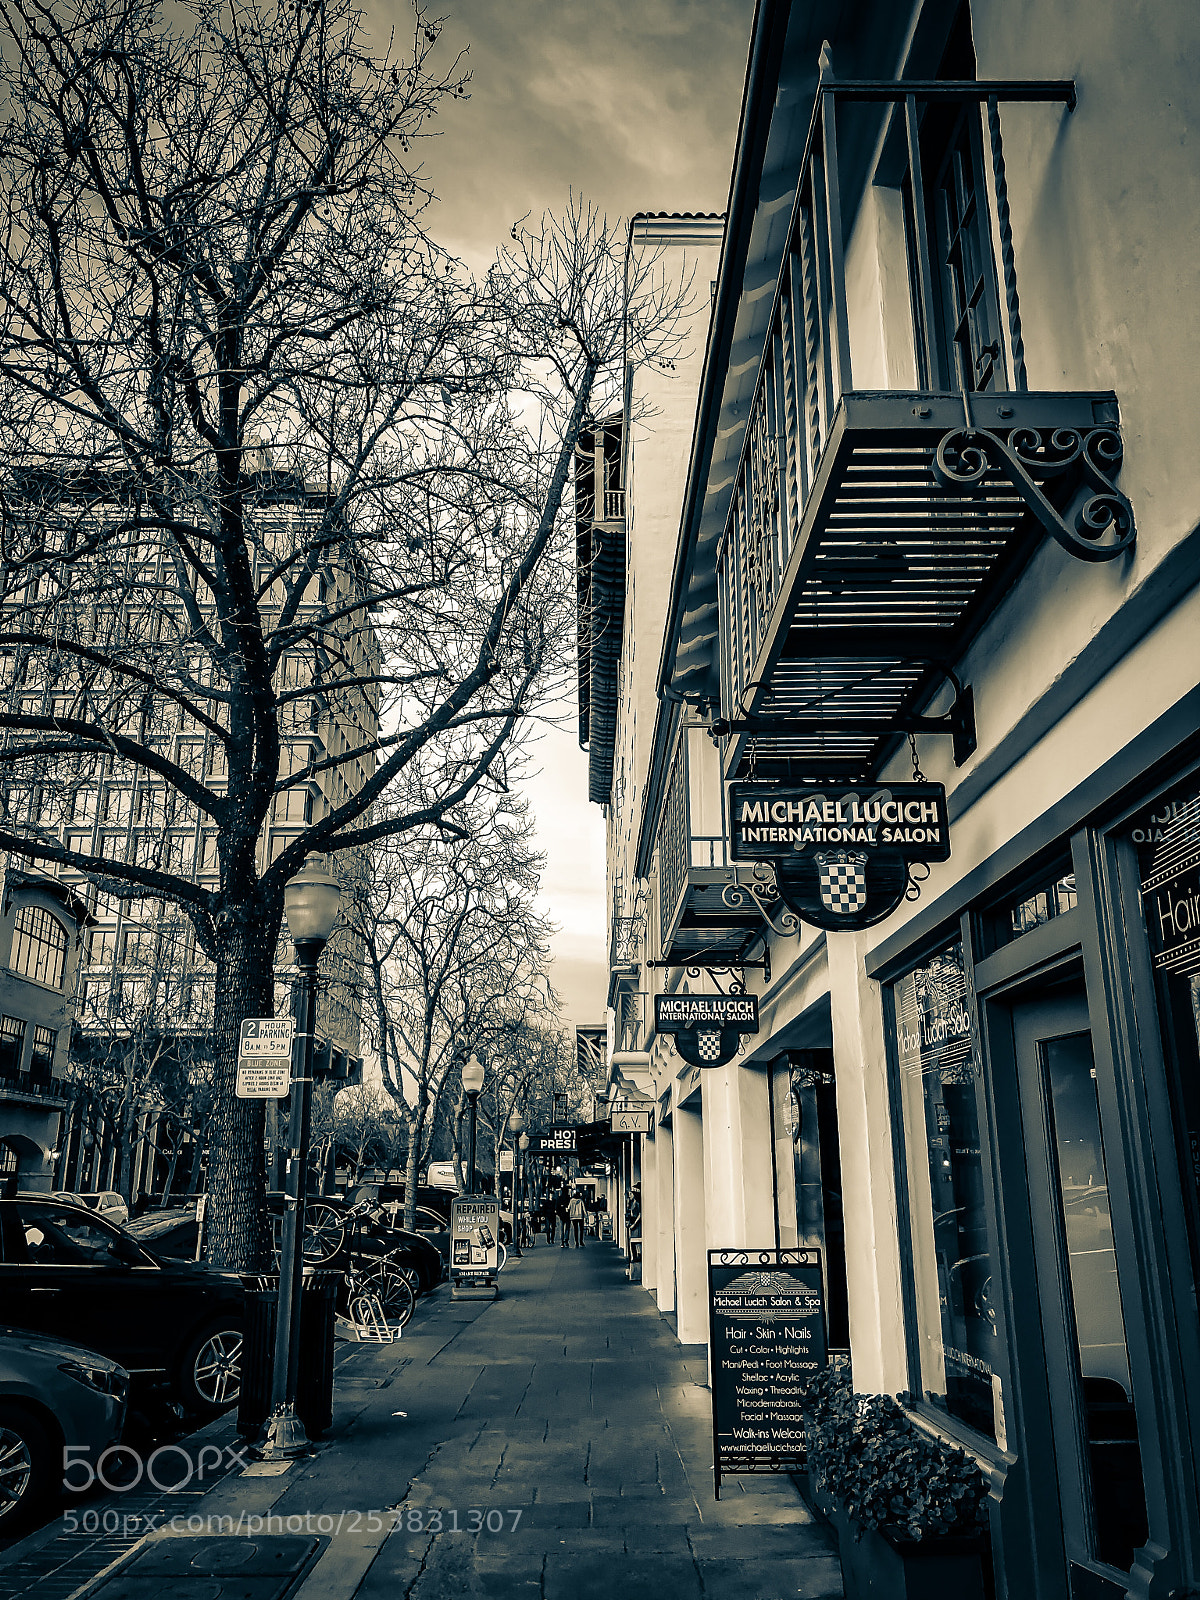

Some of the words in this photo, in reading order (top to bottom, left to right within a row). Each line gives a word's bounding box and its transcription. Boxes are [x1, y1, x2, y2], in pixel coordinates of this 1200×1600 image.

[741, 801, 847, 823] MICHAEL
[852, 801, 939, 823] LUCICH
[741, 827, 877, 842] INTERNATIONAL
[882, 827, 940, 842] SALON
[1157, 888, 1200, 941] Hair
[660, 1001, 711, 1012] MICHAEL
[713, 1001, 754, 1012] LUCICH
[659, 1012, 725, 1020] INTERNATIONAL
[726, 1012, 754, 1020] SALON
[247, 1021, 256, 1037] 2
[260, 1029, 290, 1038] PARKING
[457, 1204, 496, 1214] REPAIRED
[477, 1215, 489, 1223] YOU
[713, 1297, 742, 1306] Michael
[744, 1297, 768, 1306] Lucich
[770, 1297, 792, 1306] Salon
[795, 1297, 801, 1306] &
[804, 1297, 821, 1309] Spa
[725, 1327, 747, 1339] Hair
[755, 1327, 776, 1339] Skin
[784, 1327, 812, 1339] Nails
[729, 1345, 743, 1354] Cut
[749, 1345, 770, 1354] Color
[775, 1345, 809, 1355] Highlights
[721, 1360, 759, 1369] Mani/Pedi
[765, 1360, 783, 1369] Foot
[784, 1360, 819, 1370] Massage
[741, 1372, 769, 1382] Shellac
[775, 1372, 800, 1383] Acrylic
[735, 1385, 764, 1396] Waxing
[740, 1412, 764, 1421] Facial
[732, 1427, 770, 1439] Walk-ins
